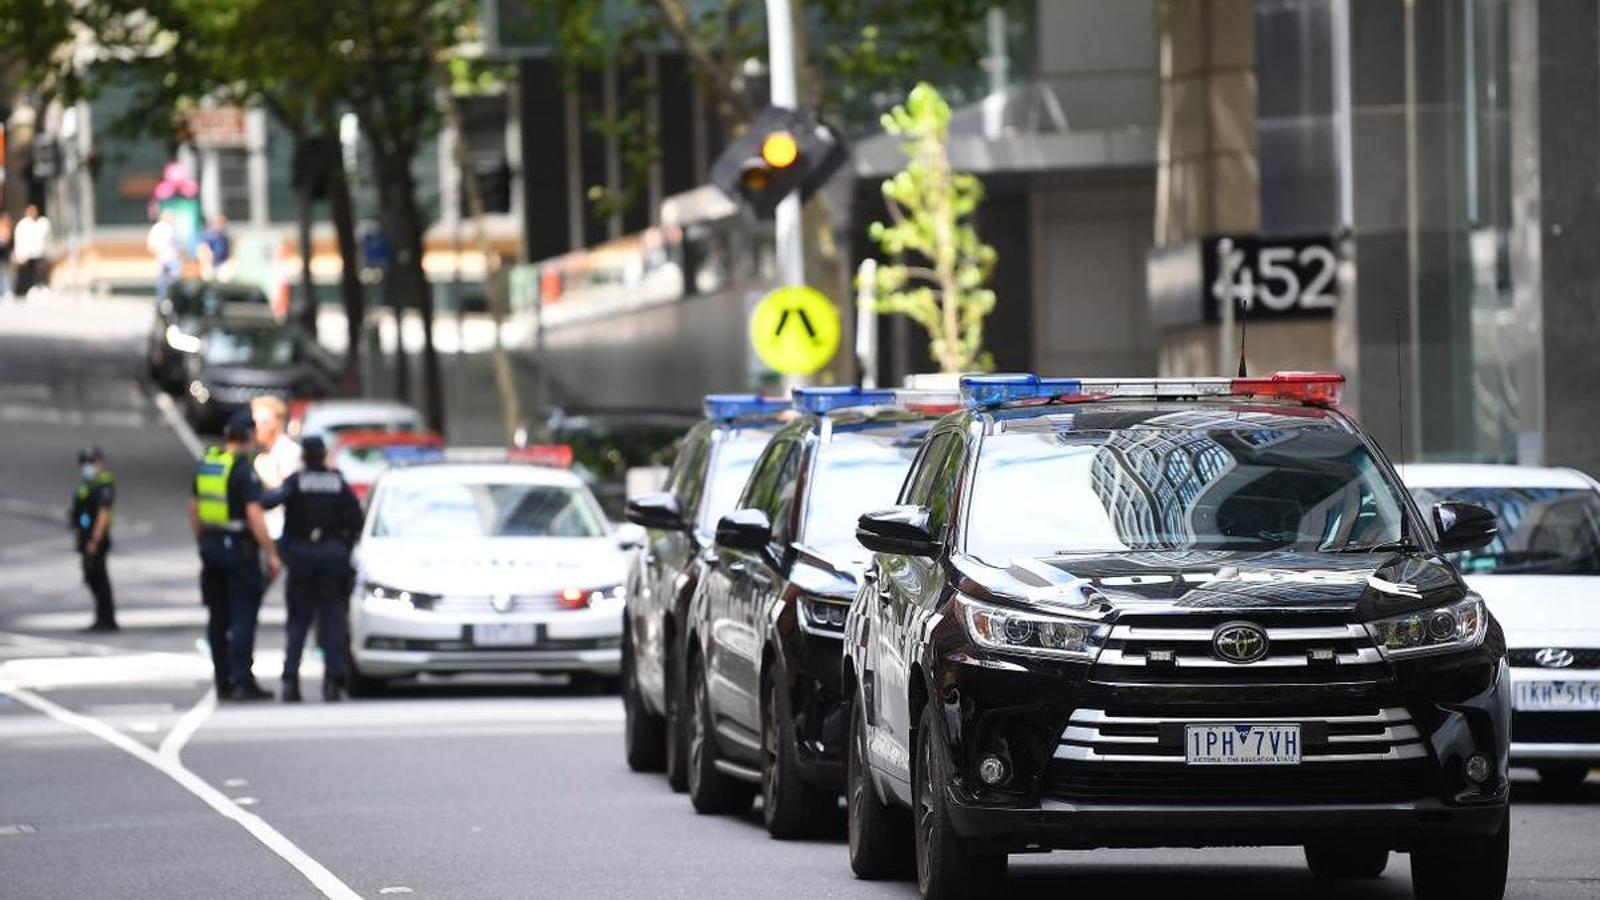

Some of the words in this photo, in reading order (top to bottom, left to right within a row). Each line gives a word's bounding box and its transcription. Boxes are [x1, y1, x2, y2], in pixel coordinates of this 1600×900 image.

[1213, 246, 1337, 310] 452
[1194, 731, 1234, 756] 1PH
[1254, 731, 1297, 756] 7VH
